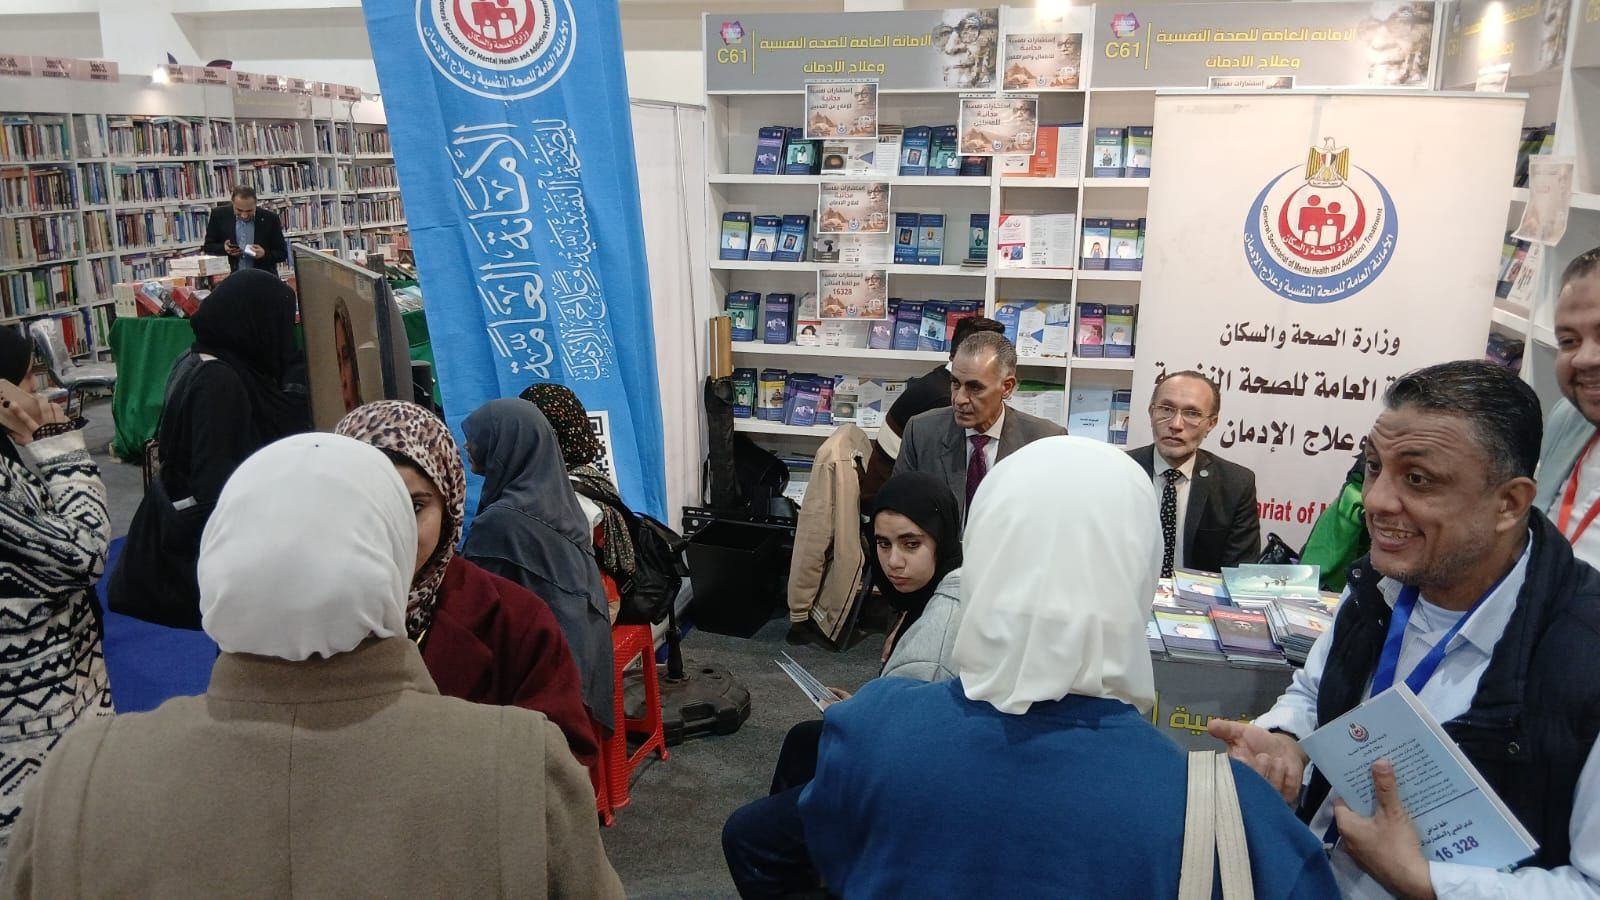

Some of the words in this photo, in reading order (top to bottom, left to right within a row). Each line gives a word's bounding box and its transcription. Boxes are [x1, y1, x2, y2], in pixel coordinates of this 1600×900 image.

[439, 0, 449, 21] eneral
[541, 0, 551, 30] Treatmen
[443, 22, 468, 53] Secretariat
[529, 30, 549, 55] Addiction
[476, 53, 498, 65] Mental
[498, 56, 520, 65] Health
[520, 51, 531, 62] and
[716, 48, 748, 64] C61
[1104, 41, 1141, 59] C61
[449, 59, 477, 85] وعلاج
[534, 52, 558, 78] العامة
[476, 70, 510, 89] النفسية
[508, 68, 538, 88] للصحة
[1262, 204, 1273, 236] General
[1363, 207, 1383, 244] Treatment
[1267, 233, 1290, 264] Secretariat
[1341, 243, 1367, 268] Addiction
[1287, 259, 1295, 268] of
[1293, 261, 1312, 274] Mental
[1311, 265, 1330, 275] Health
[1330, 262, 1341, 273] and
[1259, 266, 1283, 292] وعلاج
[1283, 278, 1316, 298] النفسية
[1317, 280, 1346, 297] للصحة
[1346, 265, 1372, 289] العامة
[832, 288, 853, 296] 16328
[1219, 321, 1286, 349] والسكان
[1290, 323, 1347, 347] الصحة
[1352, 328, 1401, 356] وزارة
[1238, 366, 1310, 397] للصحة
[1314, 370, 1377, 401] العامة
[1219, 418, 1295, 453] الإدمان
[1296, 502, 1316, 524] of
[1435, 846, 1454, 862] 16
[1451, 835, 1479, 855] 328
